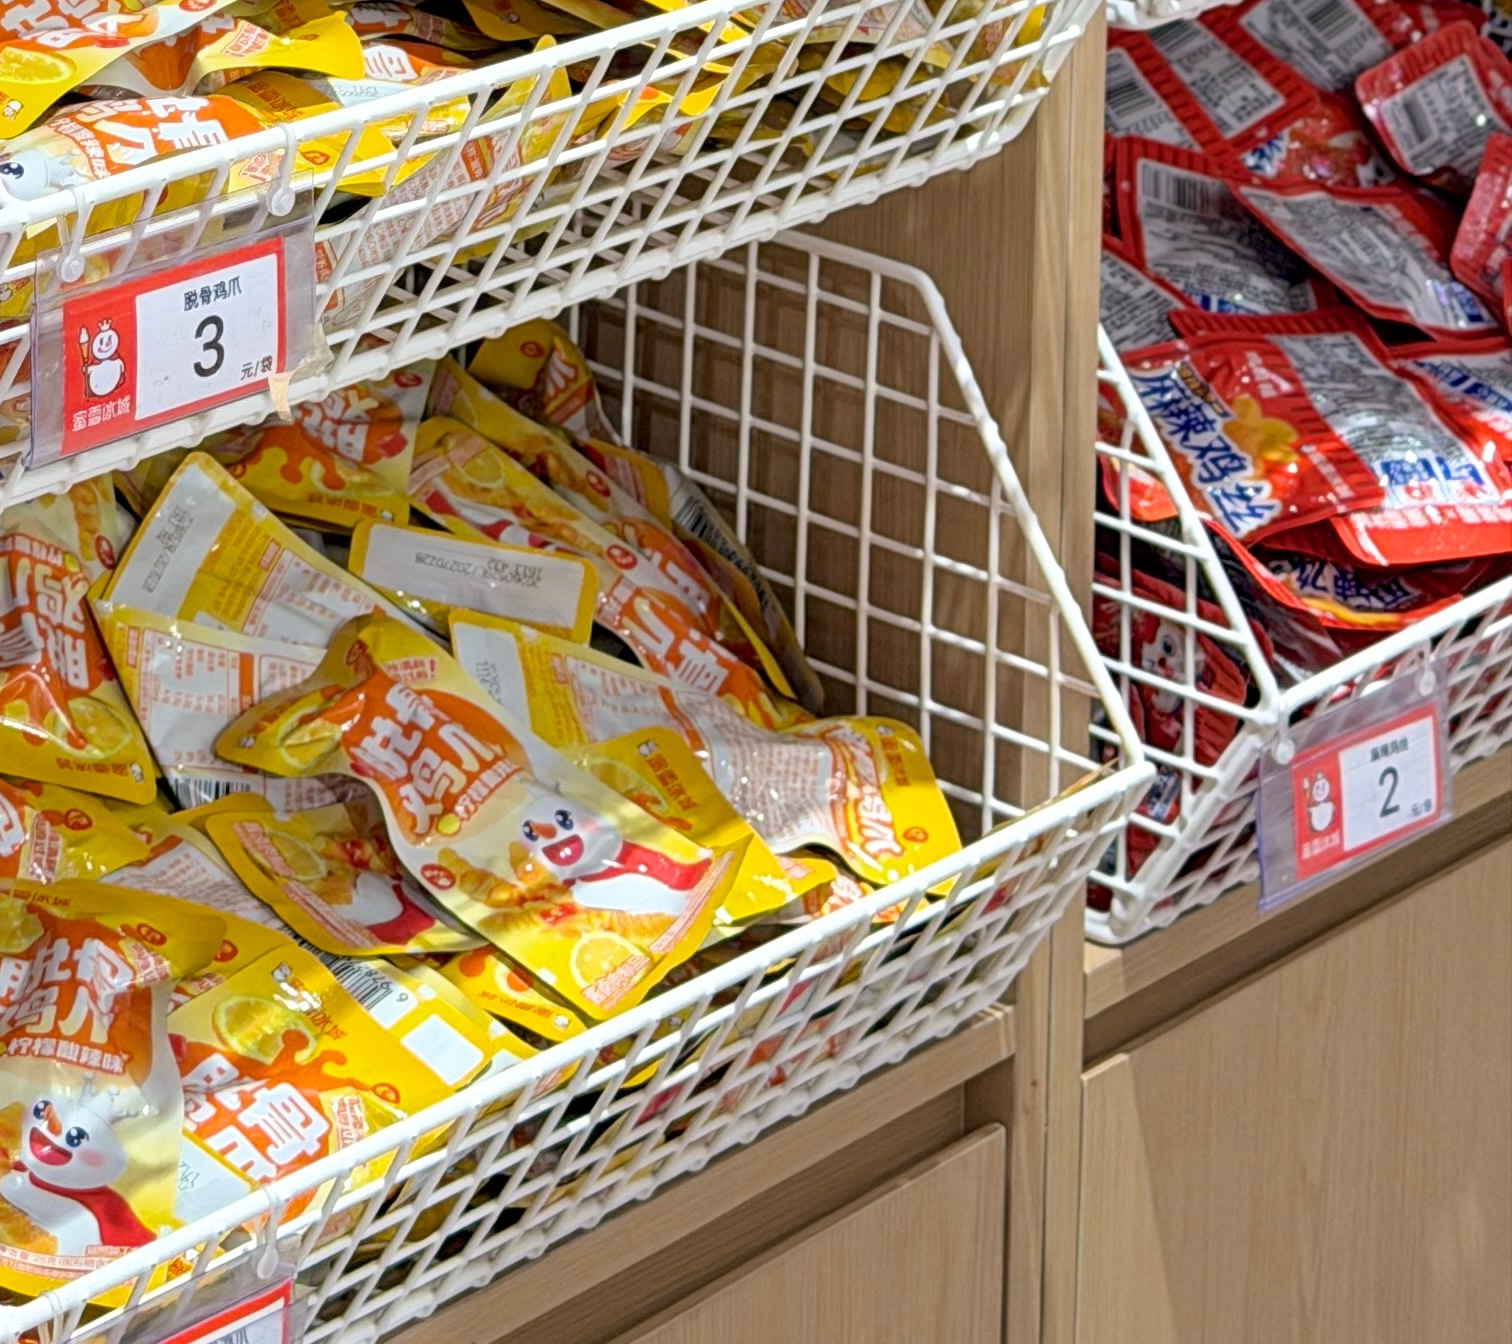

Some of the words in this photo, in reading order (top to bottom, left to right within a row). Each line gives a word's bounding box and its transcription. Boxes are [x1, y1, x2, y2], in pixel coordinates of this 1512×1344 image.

[183, 275, 243, 312] 脱骨鸡爪
[193, 314, 225, 378] 3
[72, 395, 131, 432] 蜜雪冰城
[1379, 766, 1400, 818] 2
